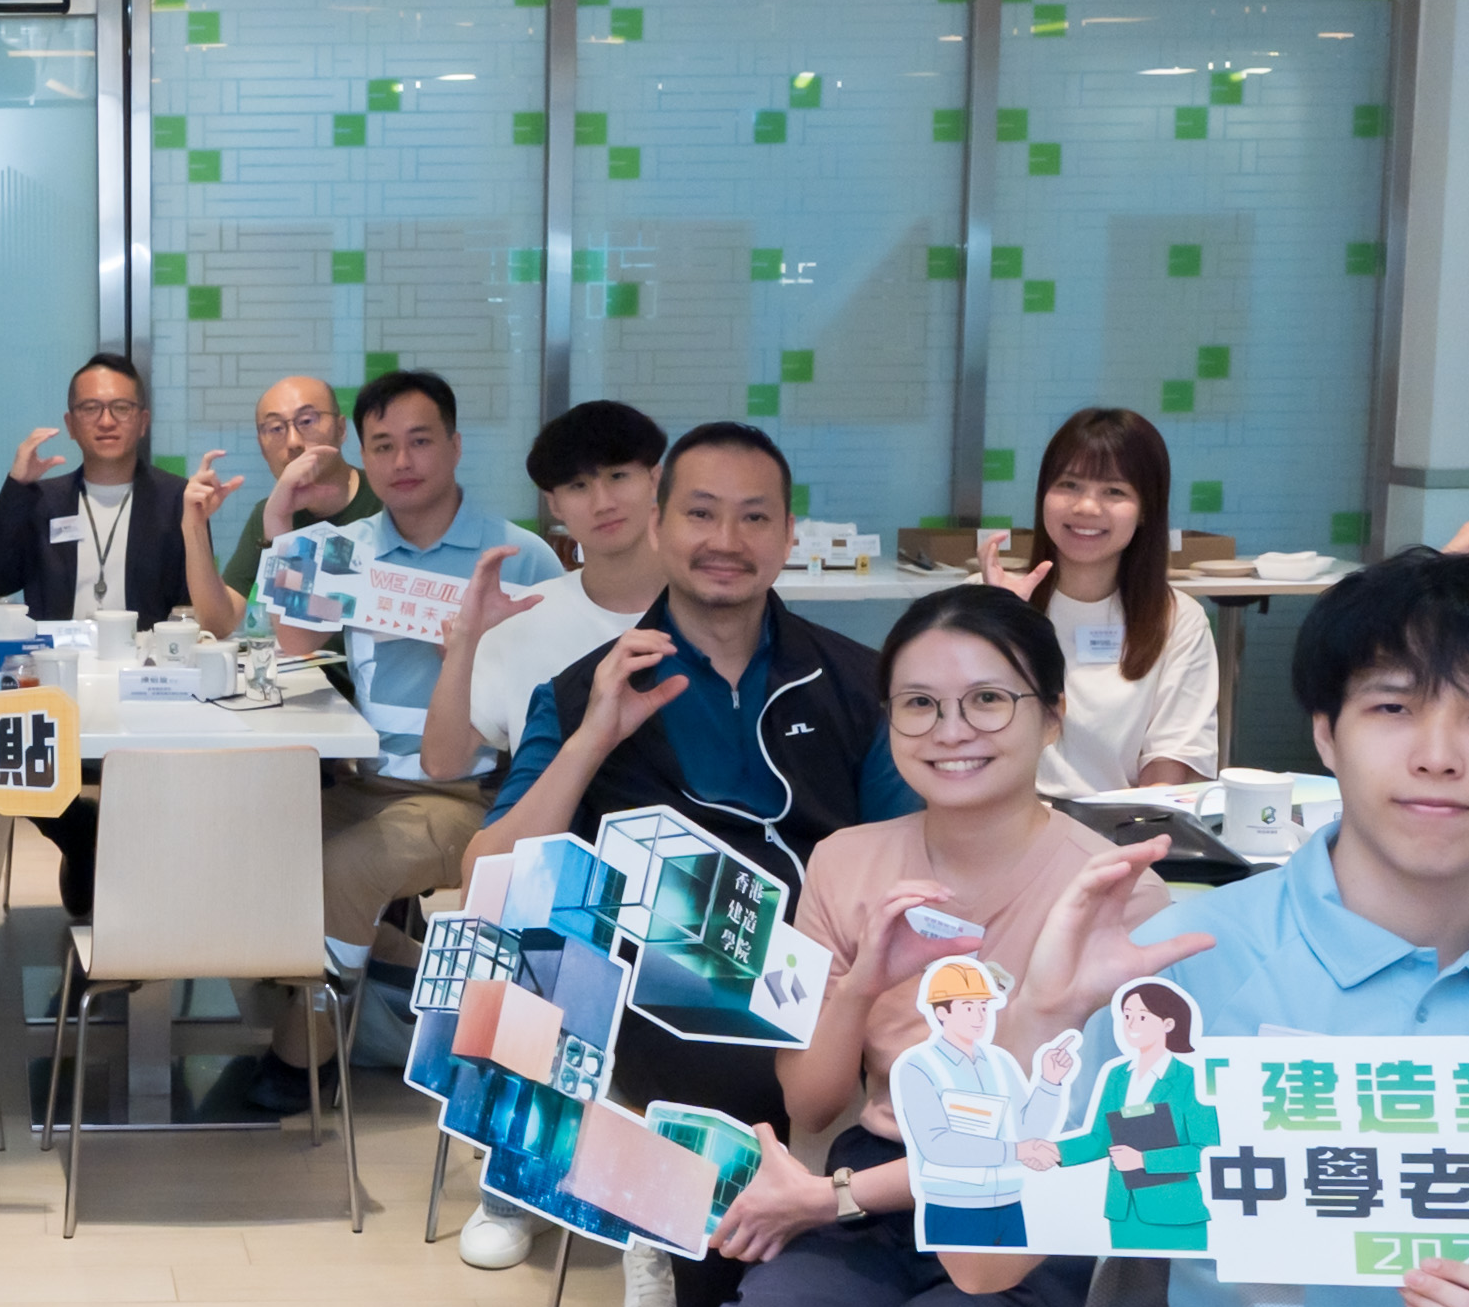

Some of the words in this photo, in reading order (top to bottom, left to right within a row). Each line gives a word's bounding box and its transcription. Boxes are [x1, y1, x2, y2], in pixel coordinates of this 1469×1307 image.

[370, 567, 408, 594] WE
[409, 577, 463, 605] BUIL
[735, 871, 764, 904] 香港
[727, 899, 758, 934] 建造
[721, 929, 752, 964] 學院
